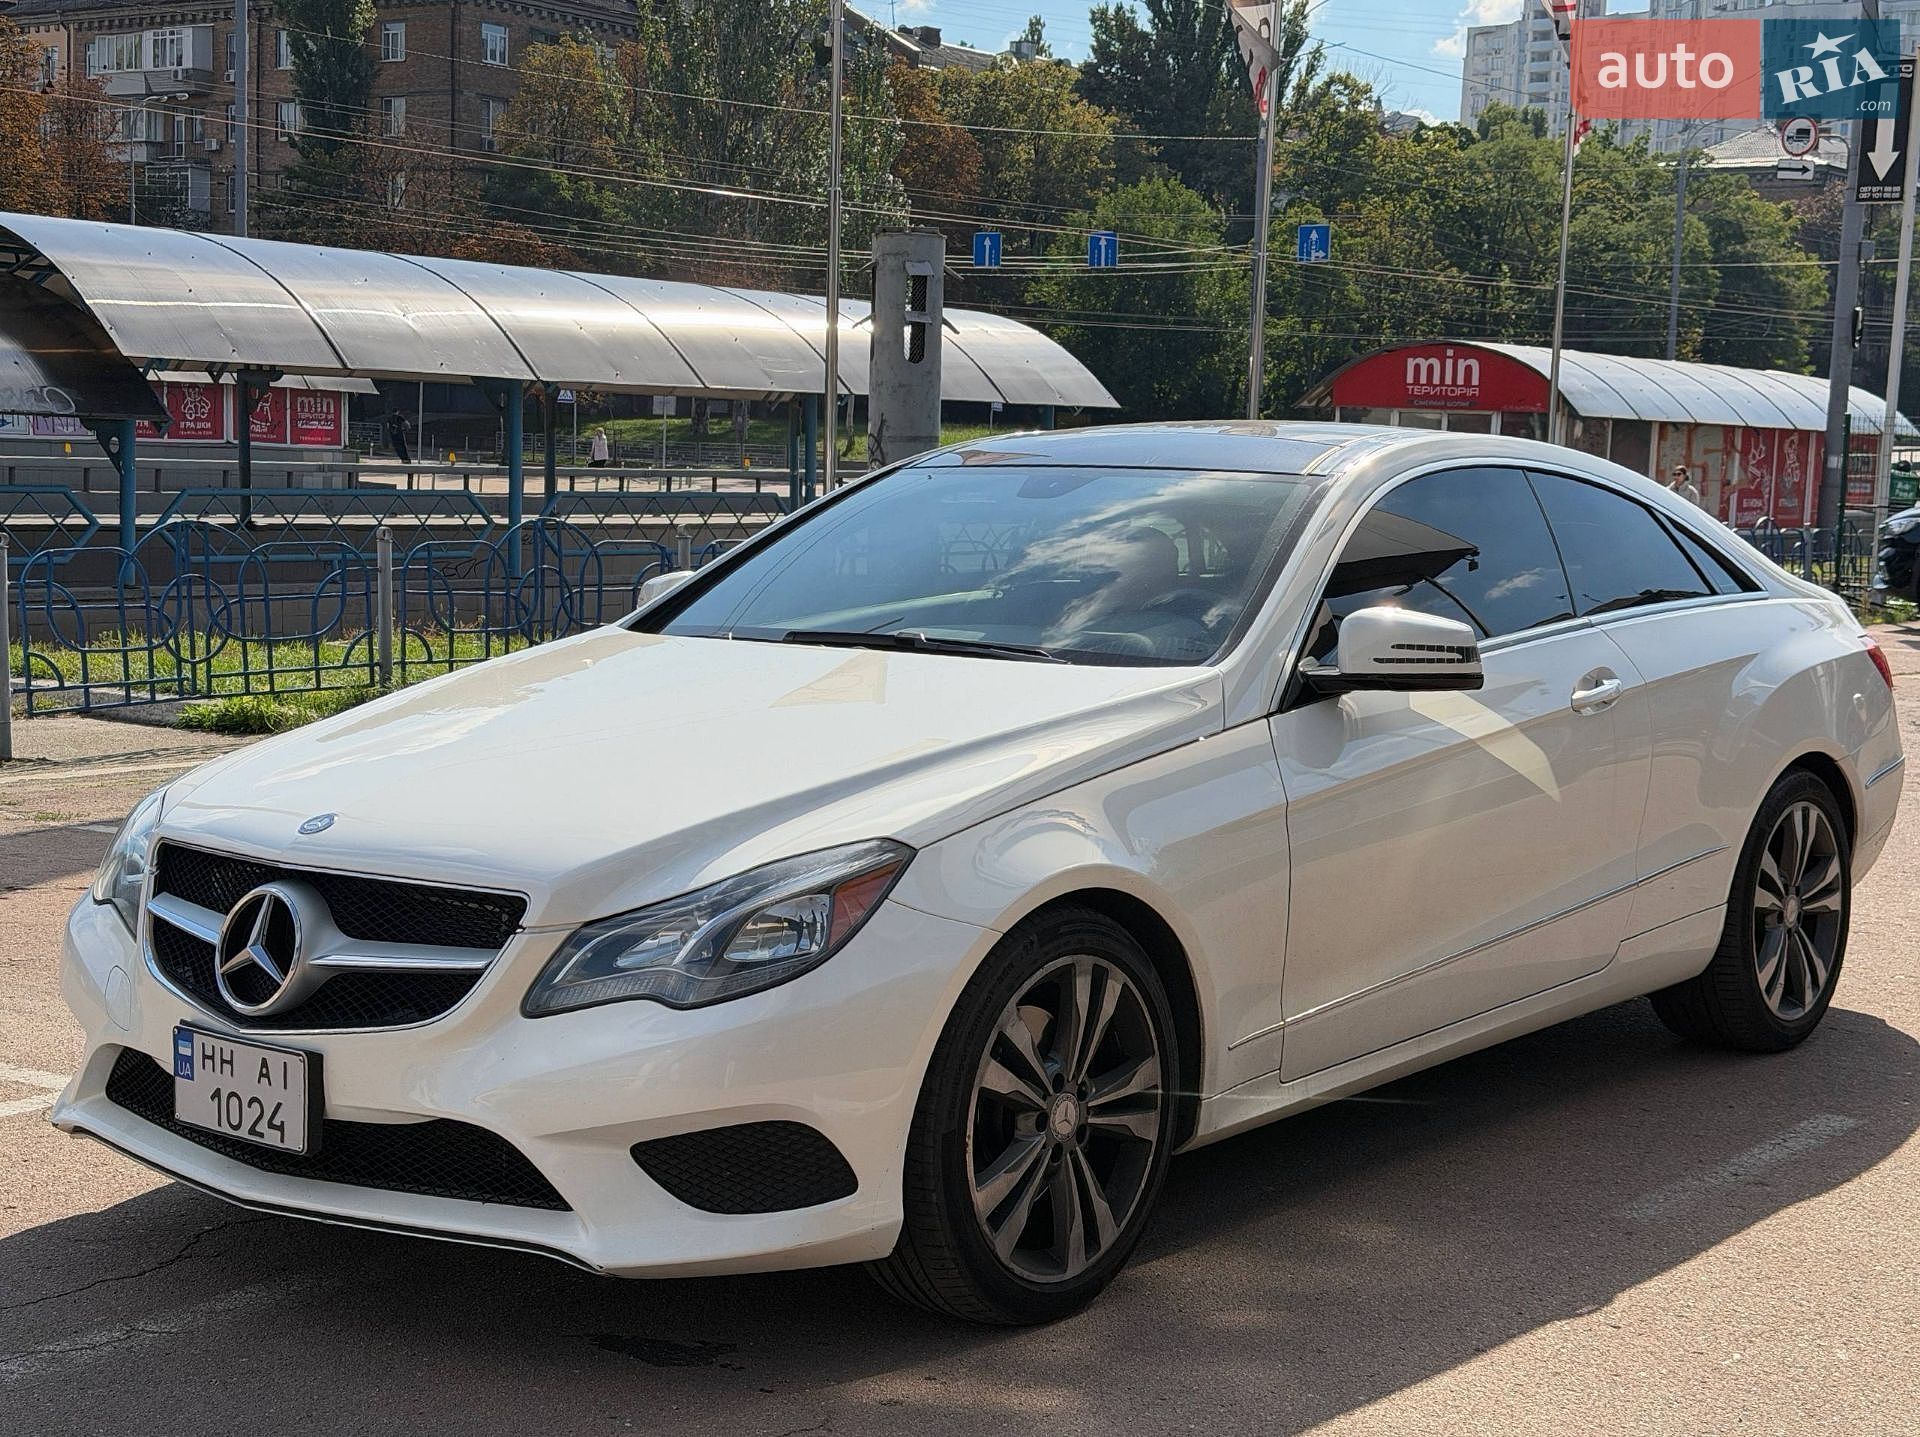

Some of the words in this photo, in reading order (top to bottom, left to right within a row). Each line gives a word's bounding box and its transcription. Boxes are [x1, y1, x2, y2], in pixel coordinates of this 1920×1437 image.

[1406, 349, 1480, 386] min
[297, 392, 335, 413] min
[1407, 385, 1480, 397] ТЕРИТОРІЯ
[178, 1060, 192, 1078] UA
[202, 1042, 234, 1078] HH
[257, 1057, 288, 1091] AI
[210, 1087, 285, 1143] 1024
